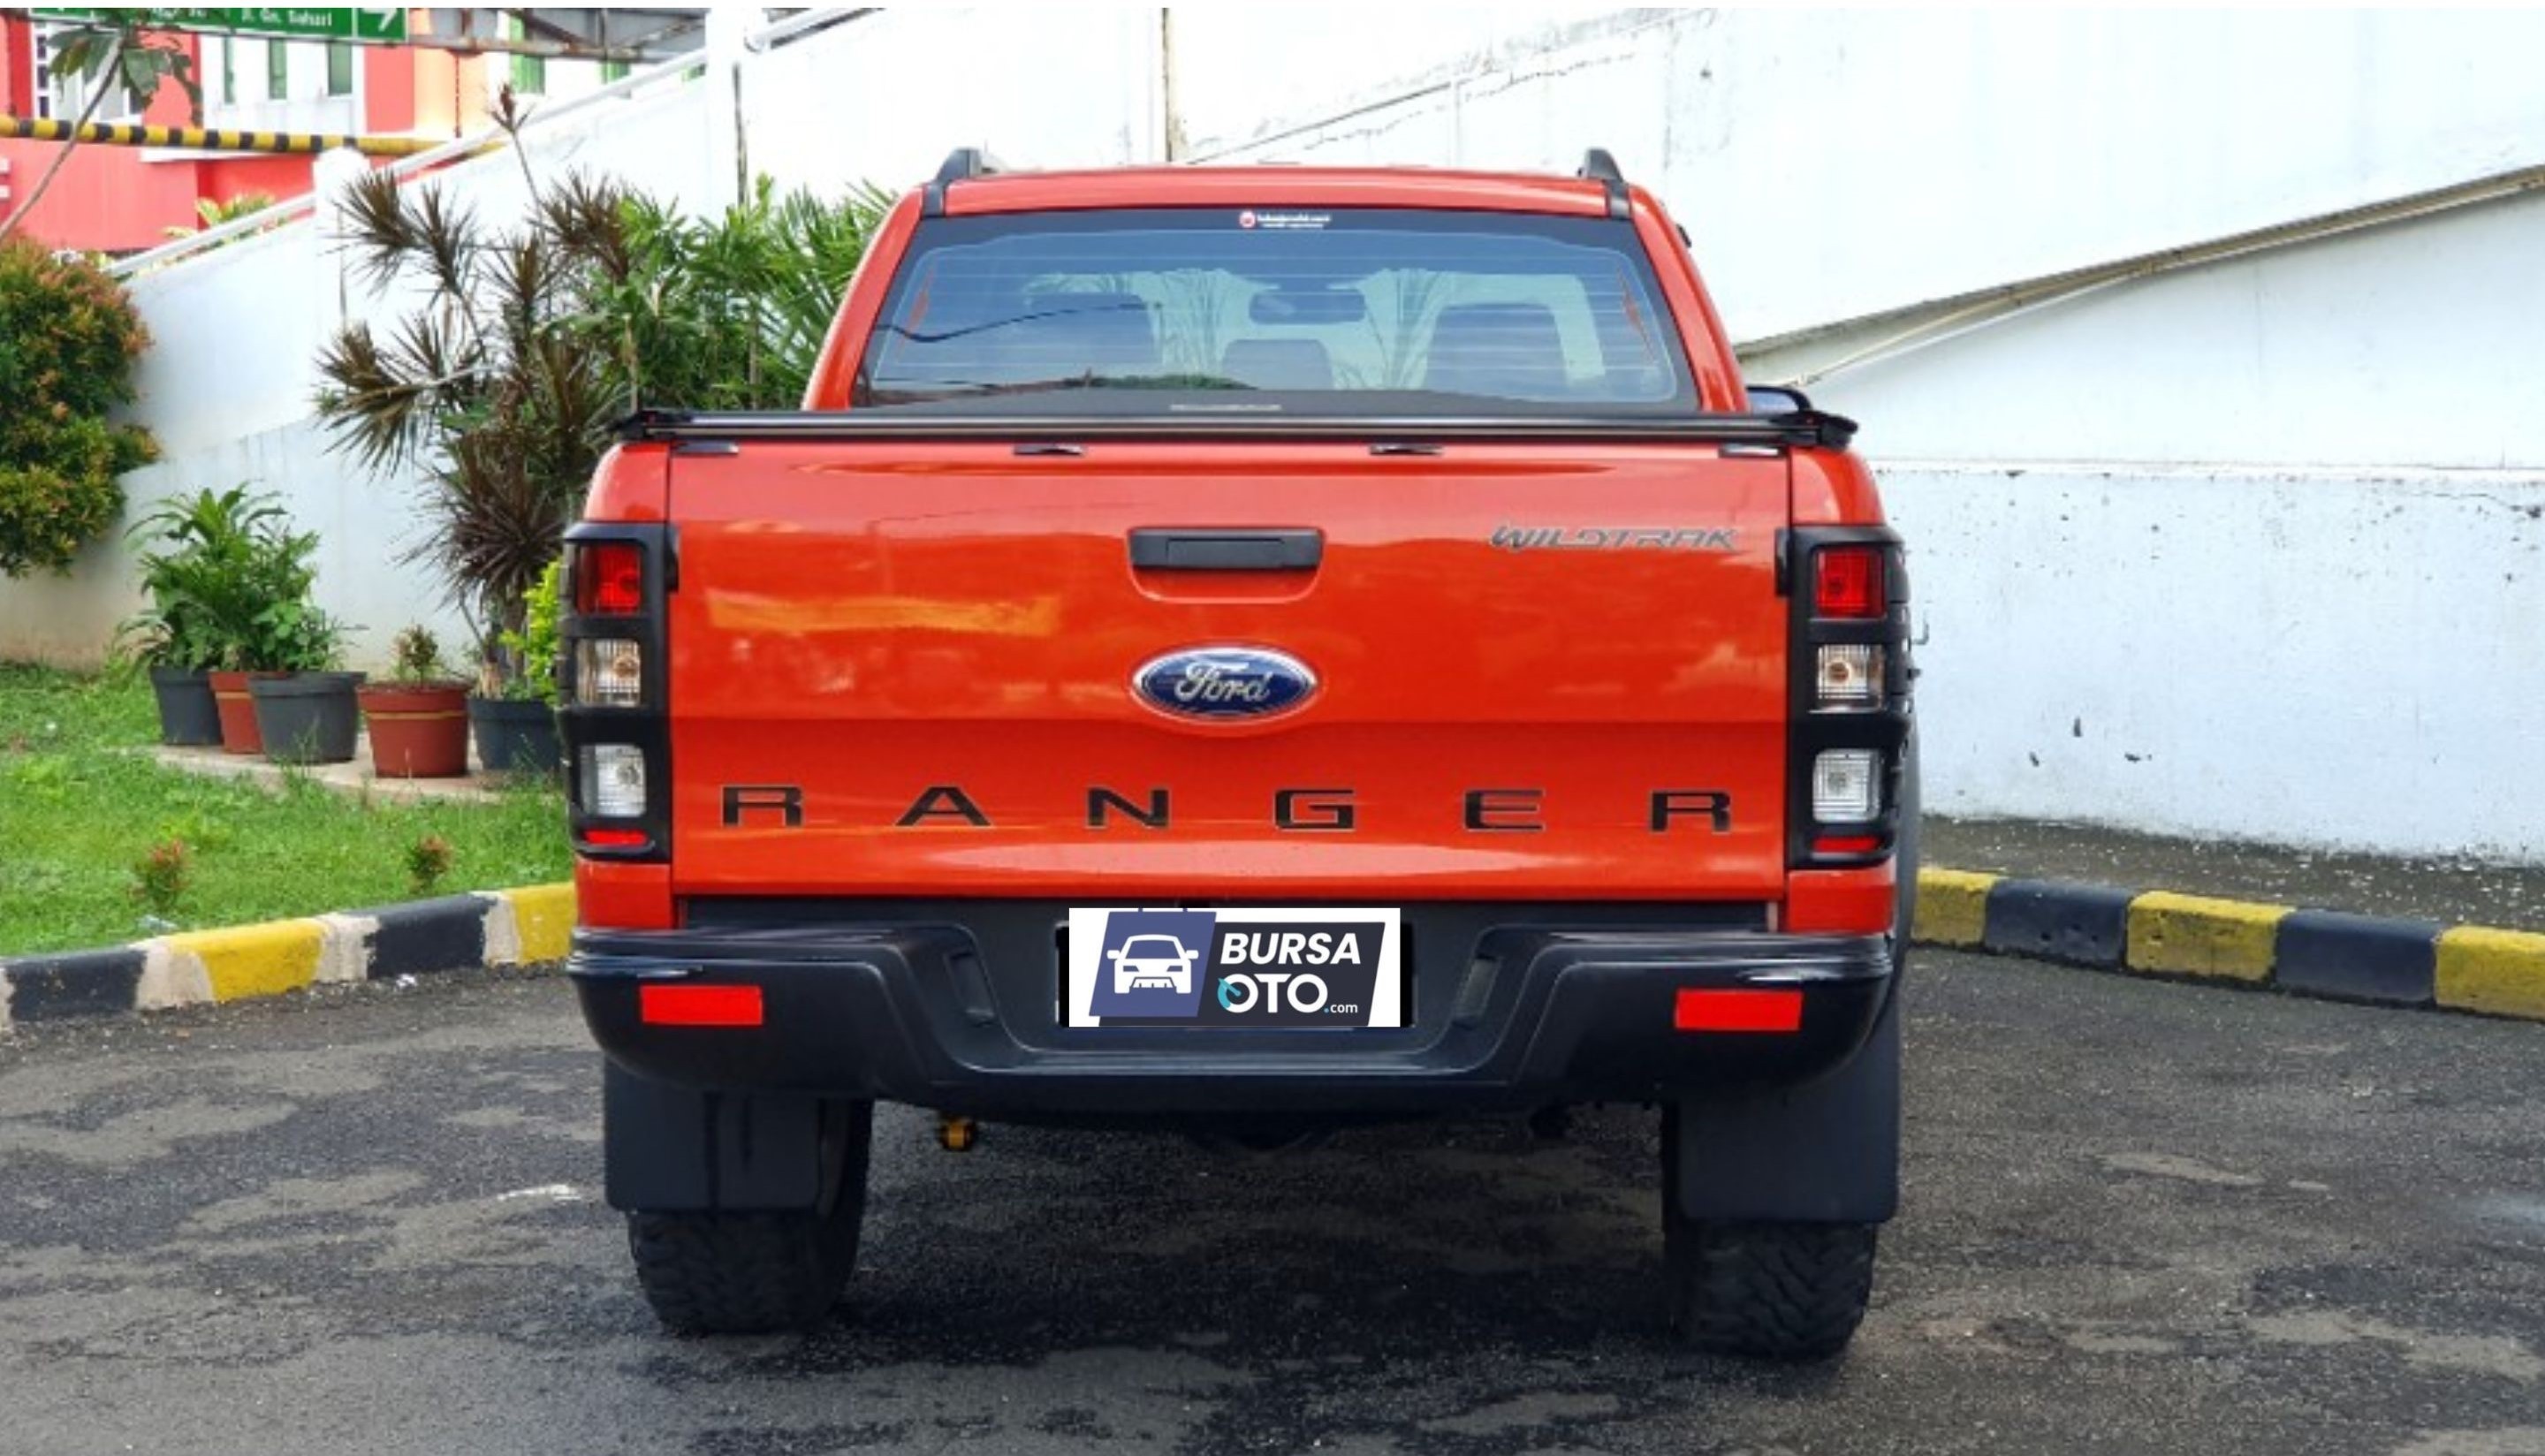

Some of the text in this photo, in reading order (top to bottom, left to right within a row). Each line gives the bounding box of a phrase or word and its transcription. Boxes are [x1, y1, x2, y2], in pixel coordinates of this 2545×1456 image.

[1490, 526, 1738, 554] WILDTRAK
[1174, 661, 1273, 701] Ford
[720, 785, 1732, 833] RANGER
